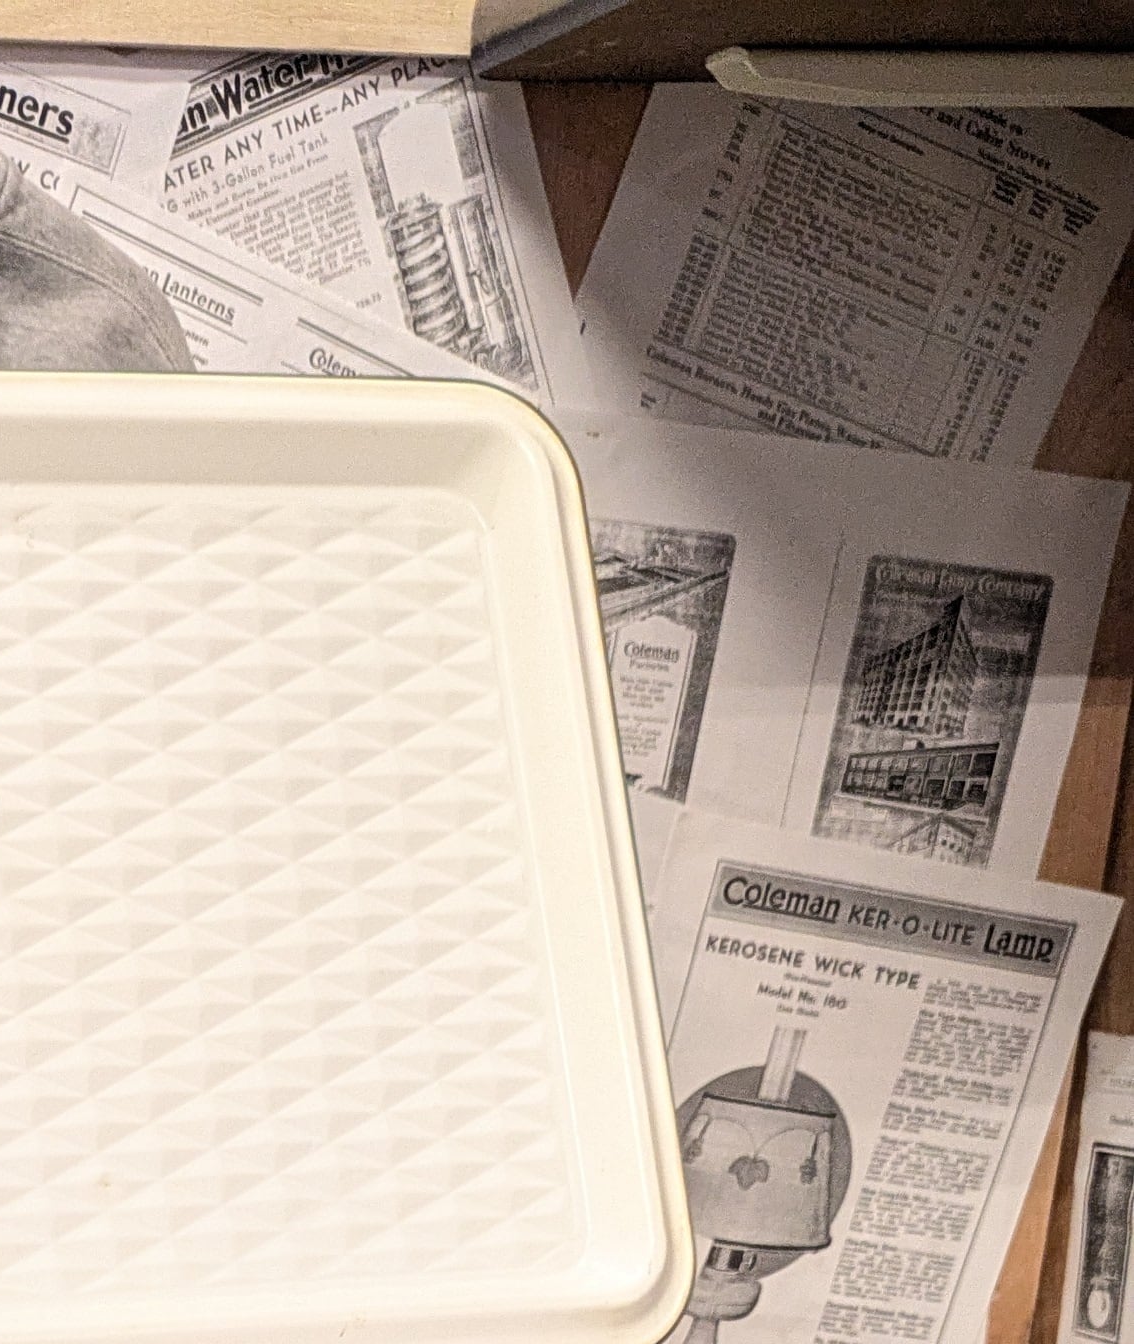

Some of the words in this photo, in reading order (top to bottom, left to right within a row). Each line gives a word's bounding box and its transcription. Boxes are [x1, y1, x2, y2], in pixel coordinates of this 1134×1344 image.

[210, 54, 310, 121] Water
[182, 187, 209, 208] with
[269, 145, 296, 168] Fuel
[298, 131, 328, 154] Tank
[224, 130, 265, 165] ANY
[162, 271, 235, 321] Lanterns
[308, 347, 363, 376] Colem
[624, 641, 680, 662] Coleman
[723, 876, 842, 922] Coleman
[983, 923, 1054, 964] Lamp
[705, 935, 804, 969] KEROSENE
[815, 953, 866, 979] WICK
[875, 966, 921, 990] TYPE
